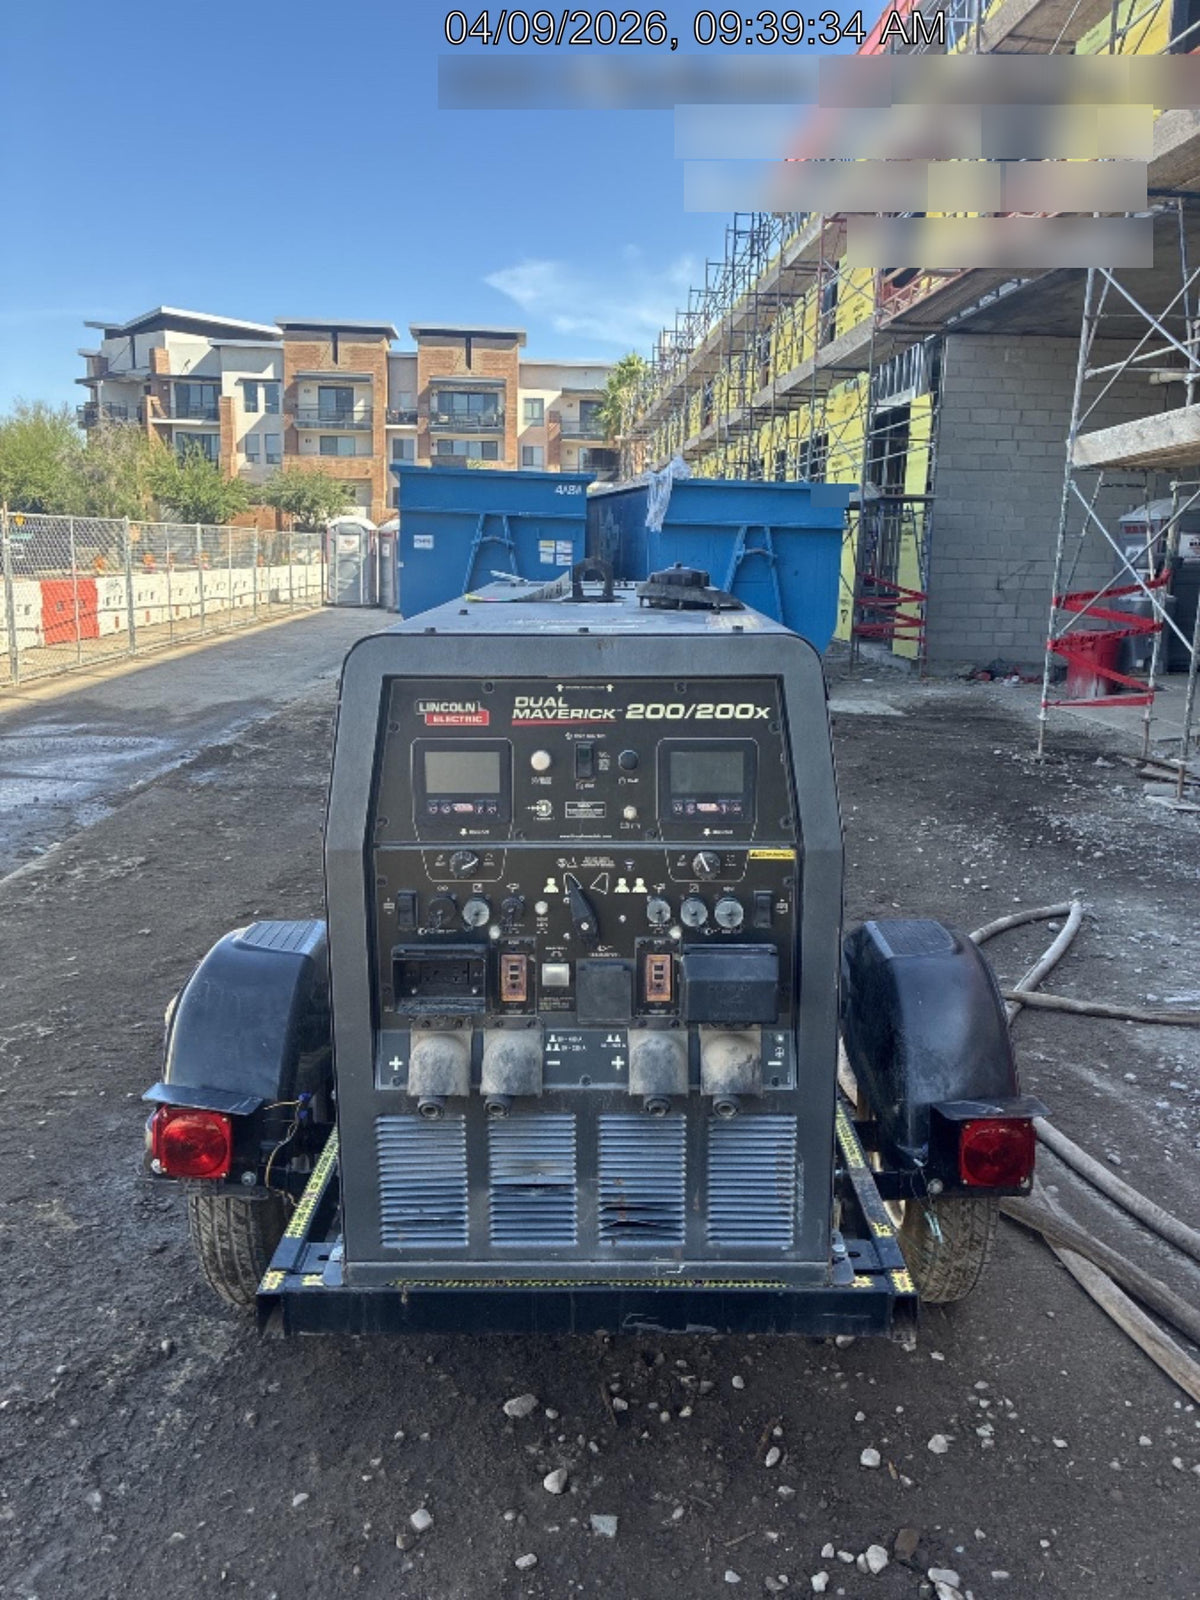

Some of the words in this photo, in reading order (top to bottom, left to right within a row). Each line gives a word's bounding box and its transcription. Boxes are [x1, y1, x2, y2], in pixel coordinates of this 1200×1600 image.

[418, 701, 476, 713] LINCOLN
[514, 696, 569, 708] DUAL
[432, 715, 484, 724] ELECTRIC
[511, 708, 616, 720] MAVERICK
